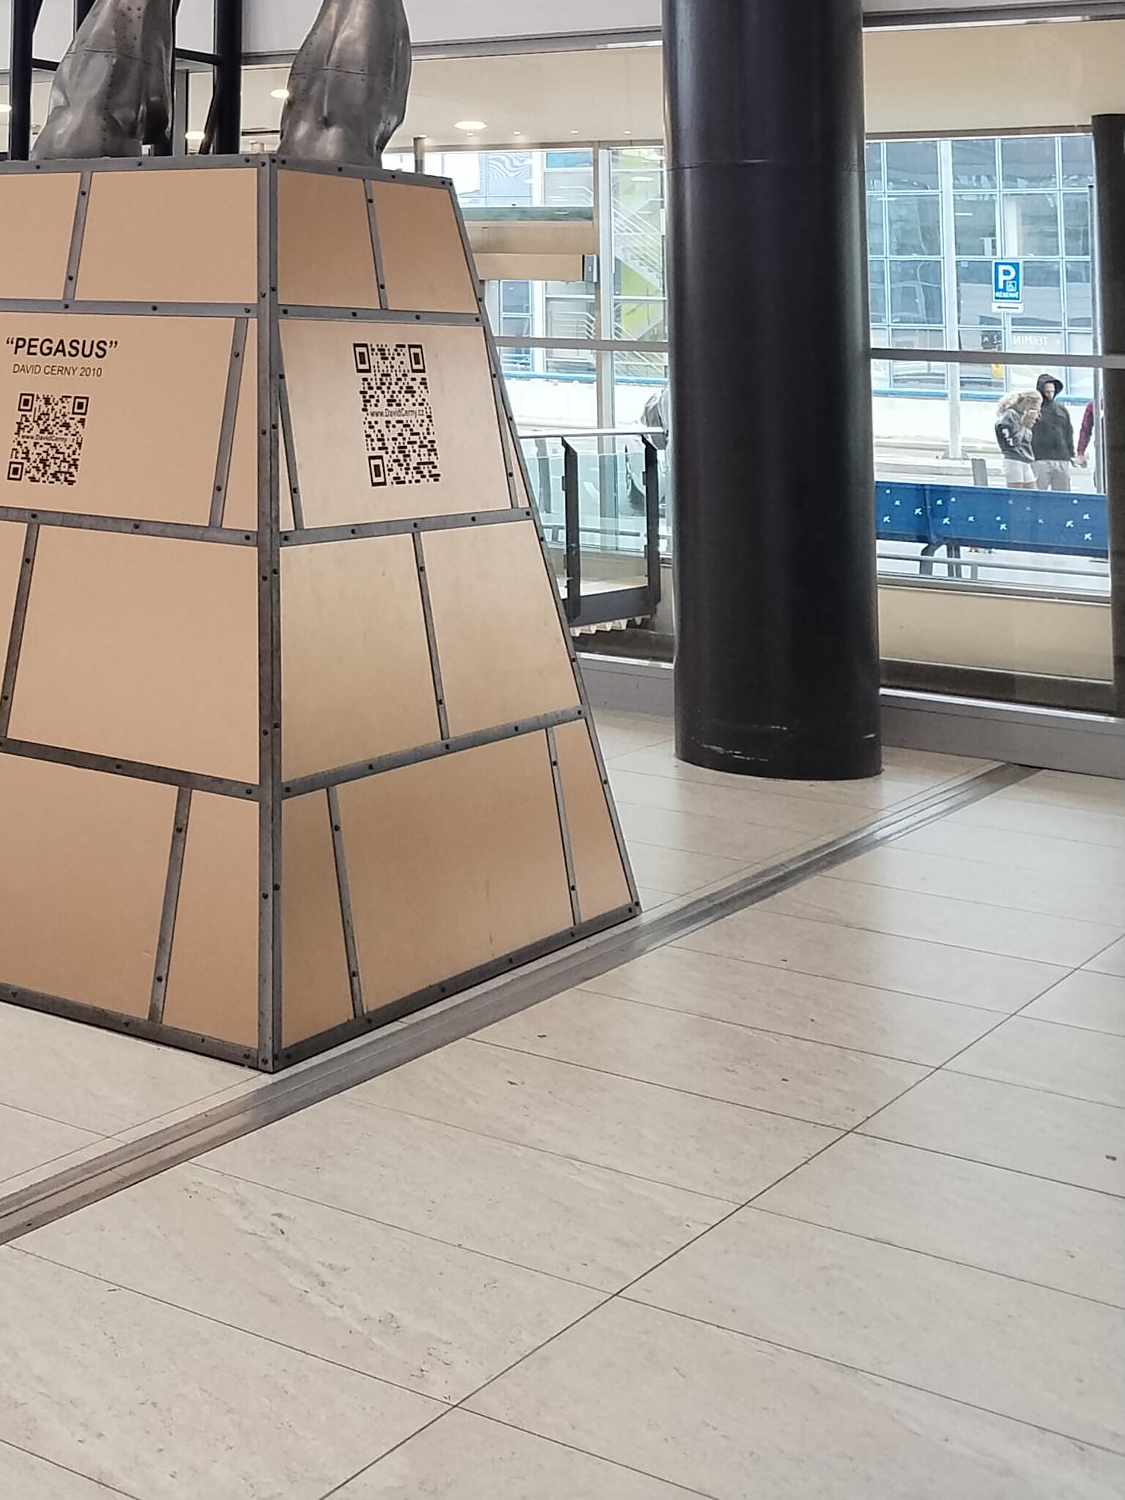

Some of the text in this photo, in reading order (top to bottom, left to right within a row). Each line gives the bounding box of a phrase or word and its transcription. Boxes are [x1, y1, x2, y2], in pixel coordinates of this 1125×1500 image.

[997, 264, 1016, 290] P
[12, 363, 103, 378] DAVID CERNY 2010
